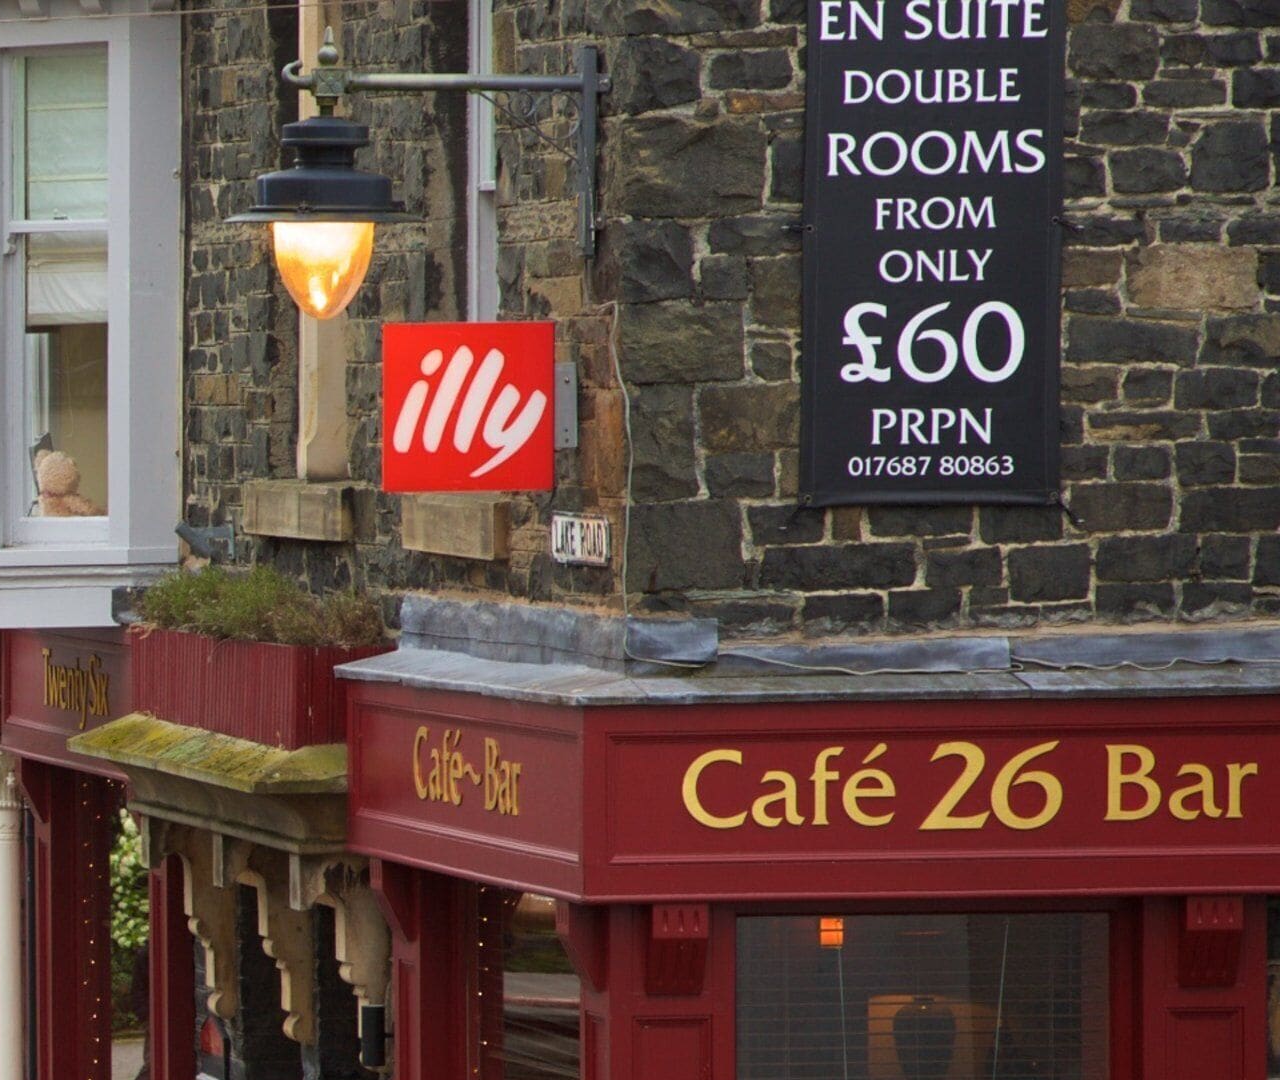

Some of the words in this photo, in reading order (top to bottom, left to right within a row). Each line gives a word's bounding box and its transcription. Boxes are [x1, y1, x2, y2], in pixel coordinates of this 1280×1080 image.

[819, 0, 886, 41] EN
[904, 0, 1049, 40] SUITE
[843, 68, 1021, 105] DOUBLE
[827, 129, 1046, 176] ROOMS
[875, 196, 997, 231] FROM
[878, 249, 994, 283] ONLY
[840, 301, 1025, 383] £60
[393, 345, 547, 478] illy
[871, 407, 993, 445] PRPN
[848, 456, 932, 476] 017687
[939, 455, 1014, 476] 80863
[555, 520, 576, 555] LAKE
[681, 742, 896, 829] Café
[918, 740, 1064, 830] 26
[1103, 743, 1259, 822] Bar
